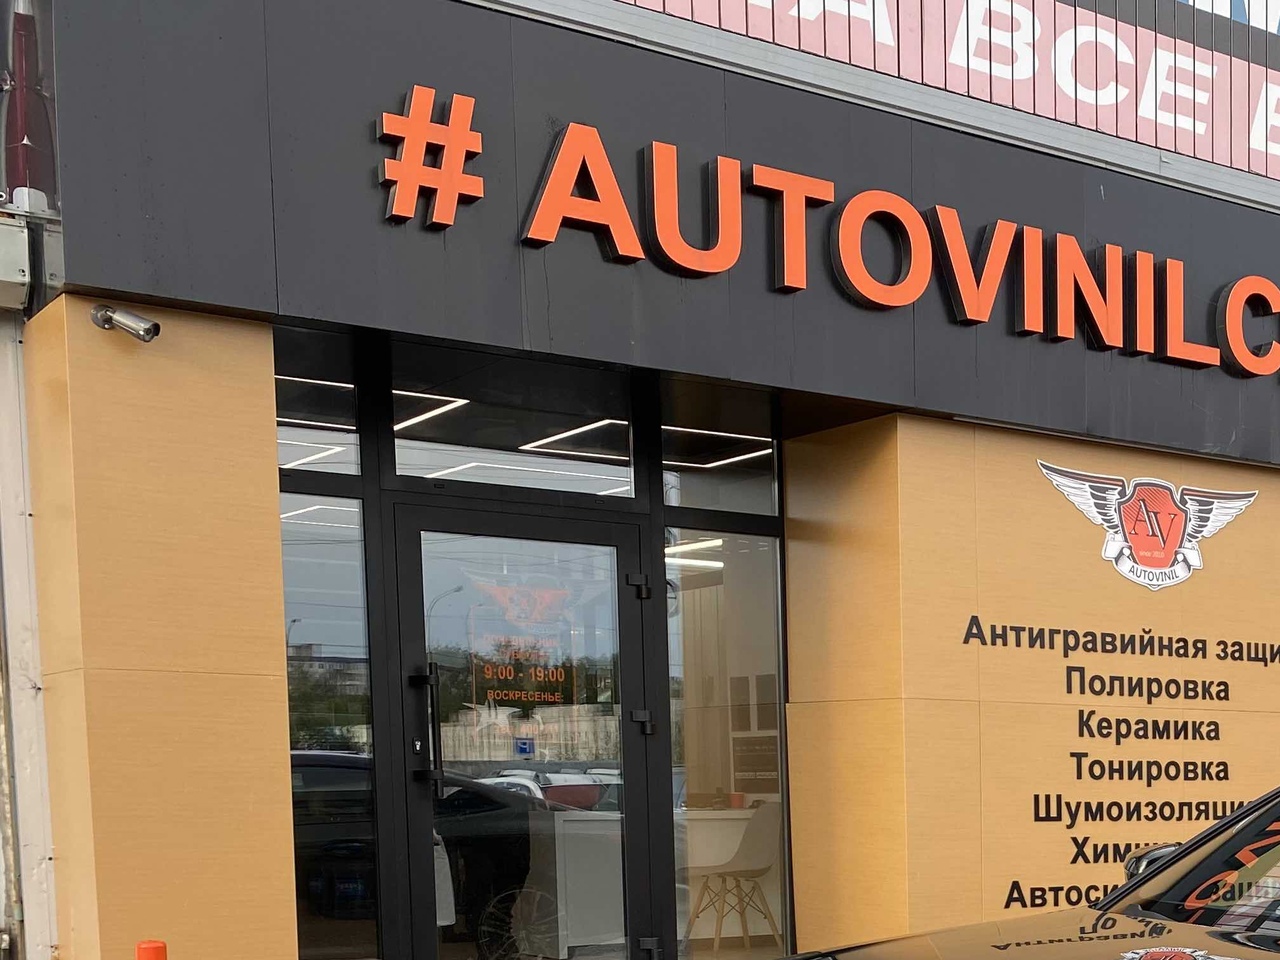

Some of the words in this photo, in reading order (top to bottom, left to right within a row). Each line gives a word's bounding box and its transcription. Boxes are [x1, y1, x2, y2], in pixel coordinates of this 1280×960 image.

[947, 0, 1218, 136] ВСЕ
[1128, 564, 1180, 583] AUTOVINIL
[962, 615, 1207, 660] Антигравийная
[484, 664, 514, 680] 9:00
[528, 666, 565, 682] 19:00
[1065, 665, 1230, 704] Полировка
[1077, 709, 1220, 746] Керамика
[1070, 752, 1230, 787] Тонировка
[1033, 793, 1251, 829] Шумоизоляци
